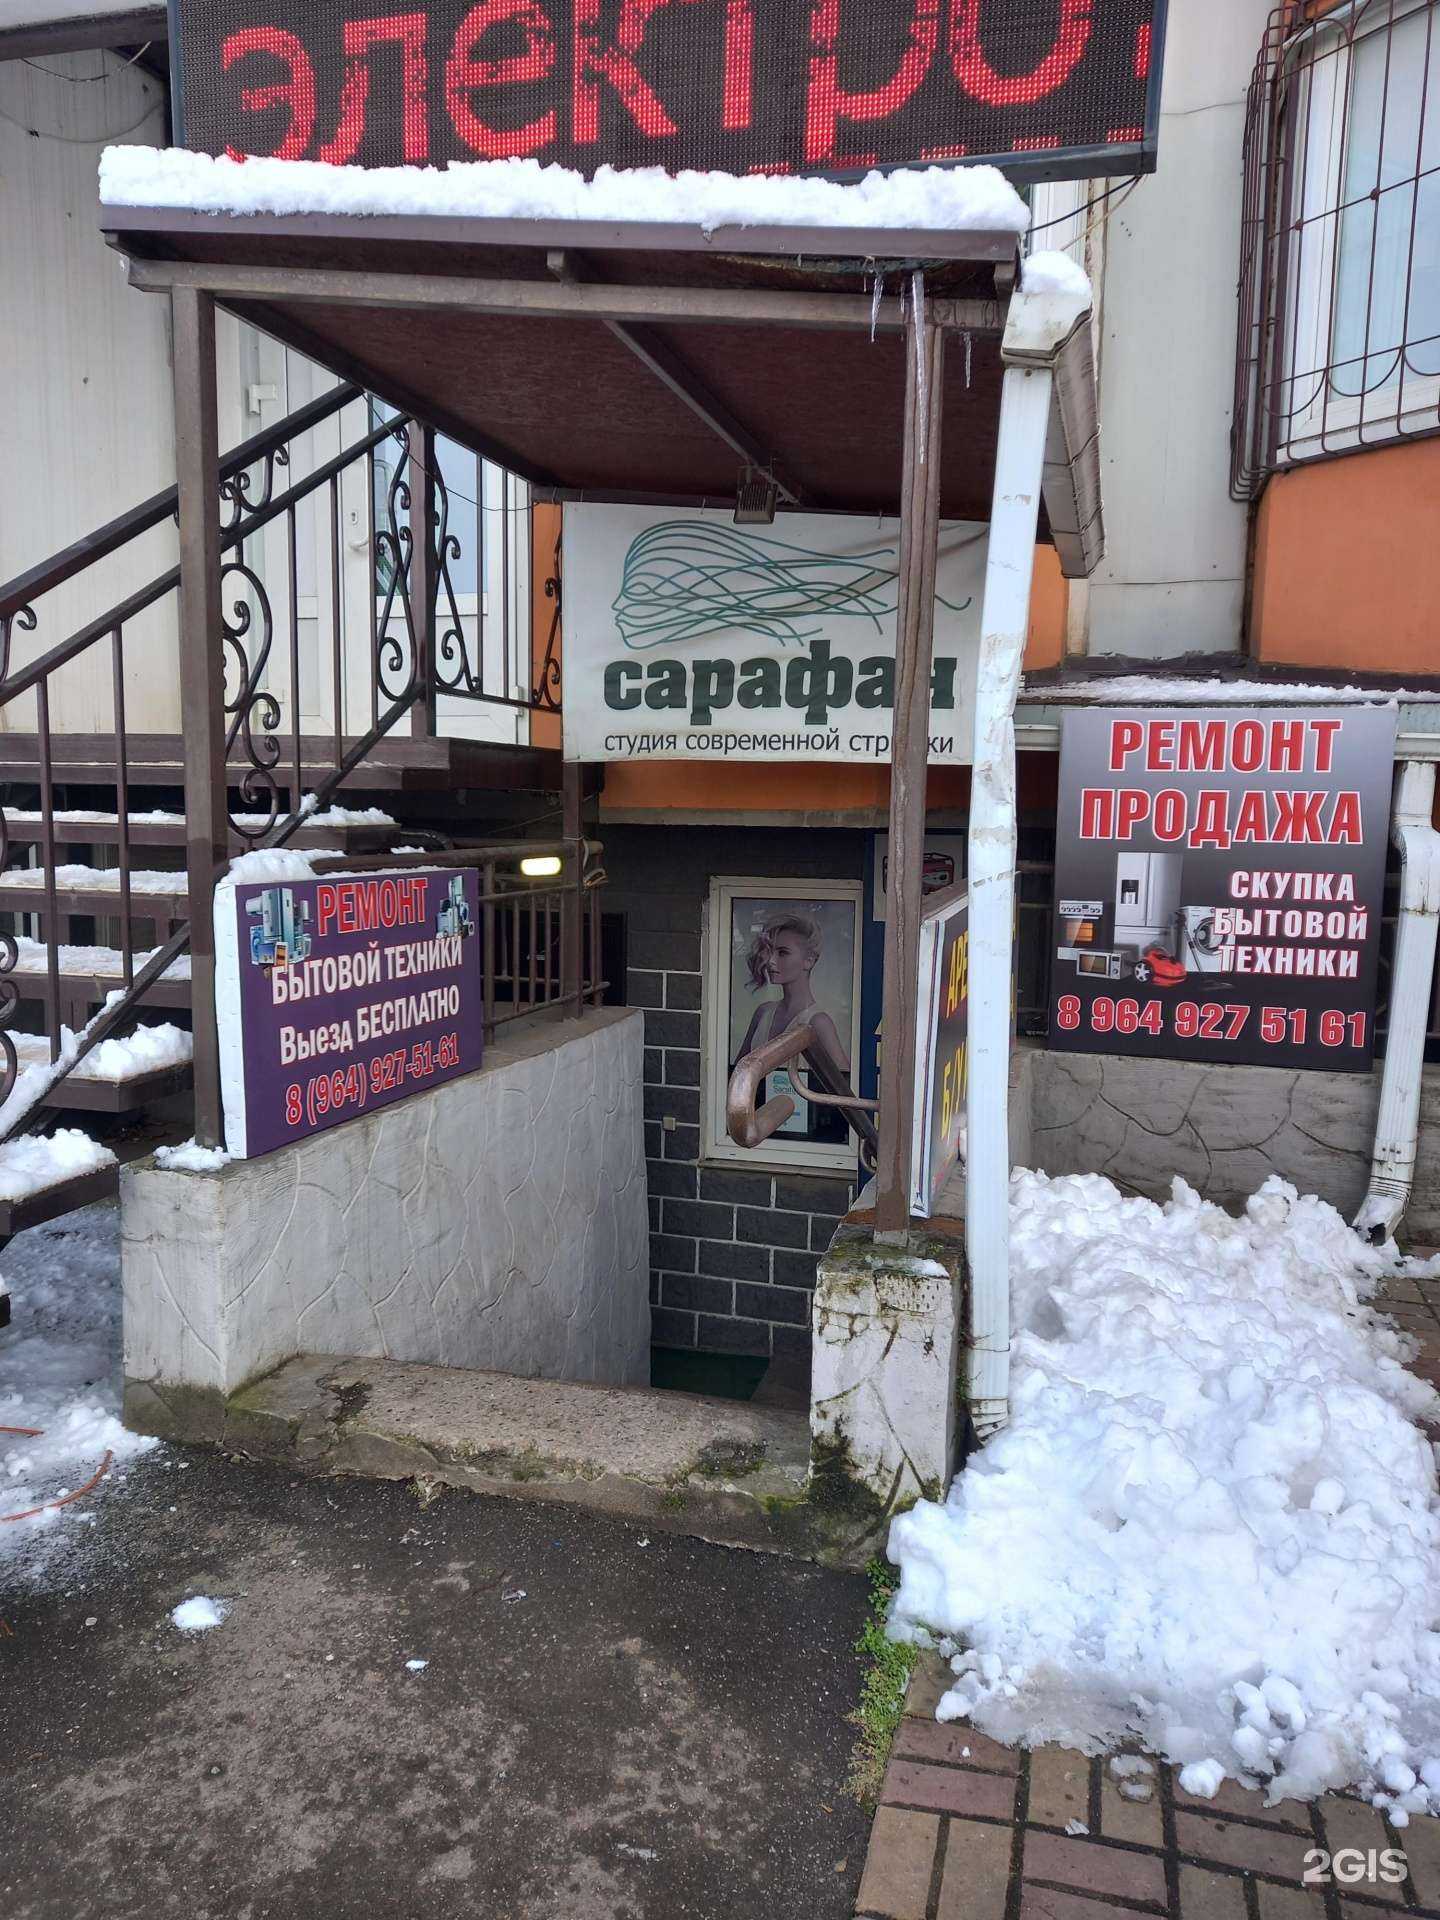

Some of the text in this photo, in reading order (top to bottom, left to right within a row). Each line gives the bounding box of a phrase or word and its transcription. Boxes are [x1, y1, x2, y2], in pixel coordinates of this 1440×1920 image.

[221, 0, 1153, 165] электро
[604, 727, 954, 758] студия современной стрки
[1108, 718, 1343, 774] РЕМОНТ
[1079, 788, 1364, 850] ПРОДАЖА
[316, 876, 429, 937] РЕМОНТ
[1230, 869, 1355, 902] СКУПКА
[1213, 904, 1369, 941] БЫТОВОЙ
[271, 936, 463, 1005] БЫТОВОЙ ТЕХНИКИ
[1217, 943, 1360, 979] ТЕХНИКИ
[279, 984, 460, 1066] Выезд БЕСПЛАТНО
[1056, 994, 1367, 1048] 8 964 927 51 61
[285, 1032, 460, 1126] 8 (964) 927-51-61
